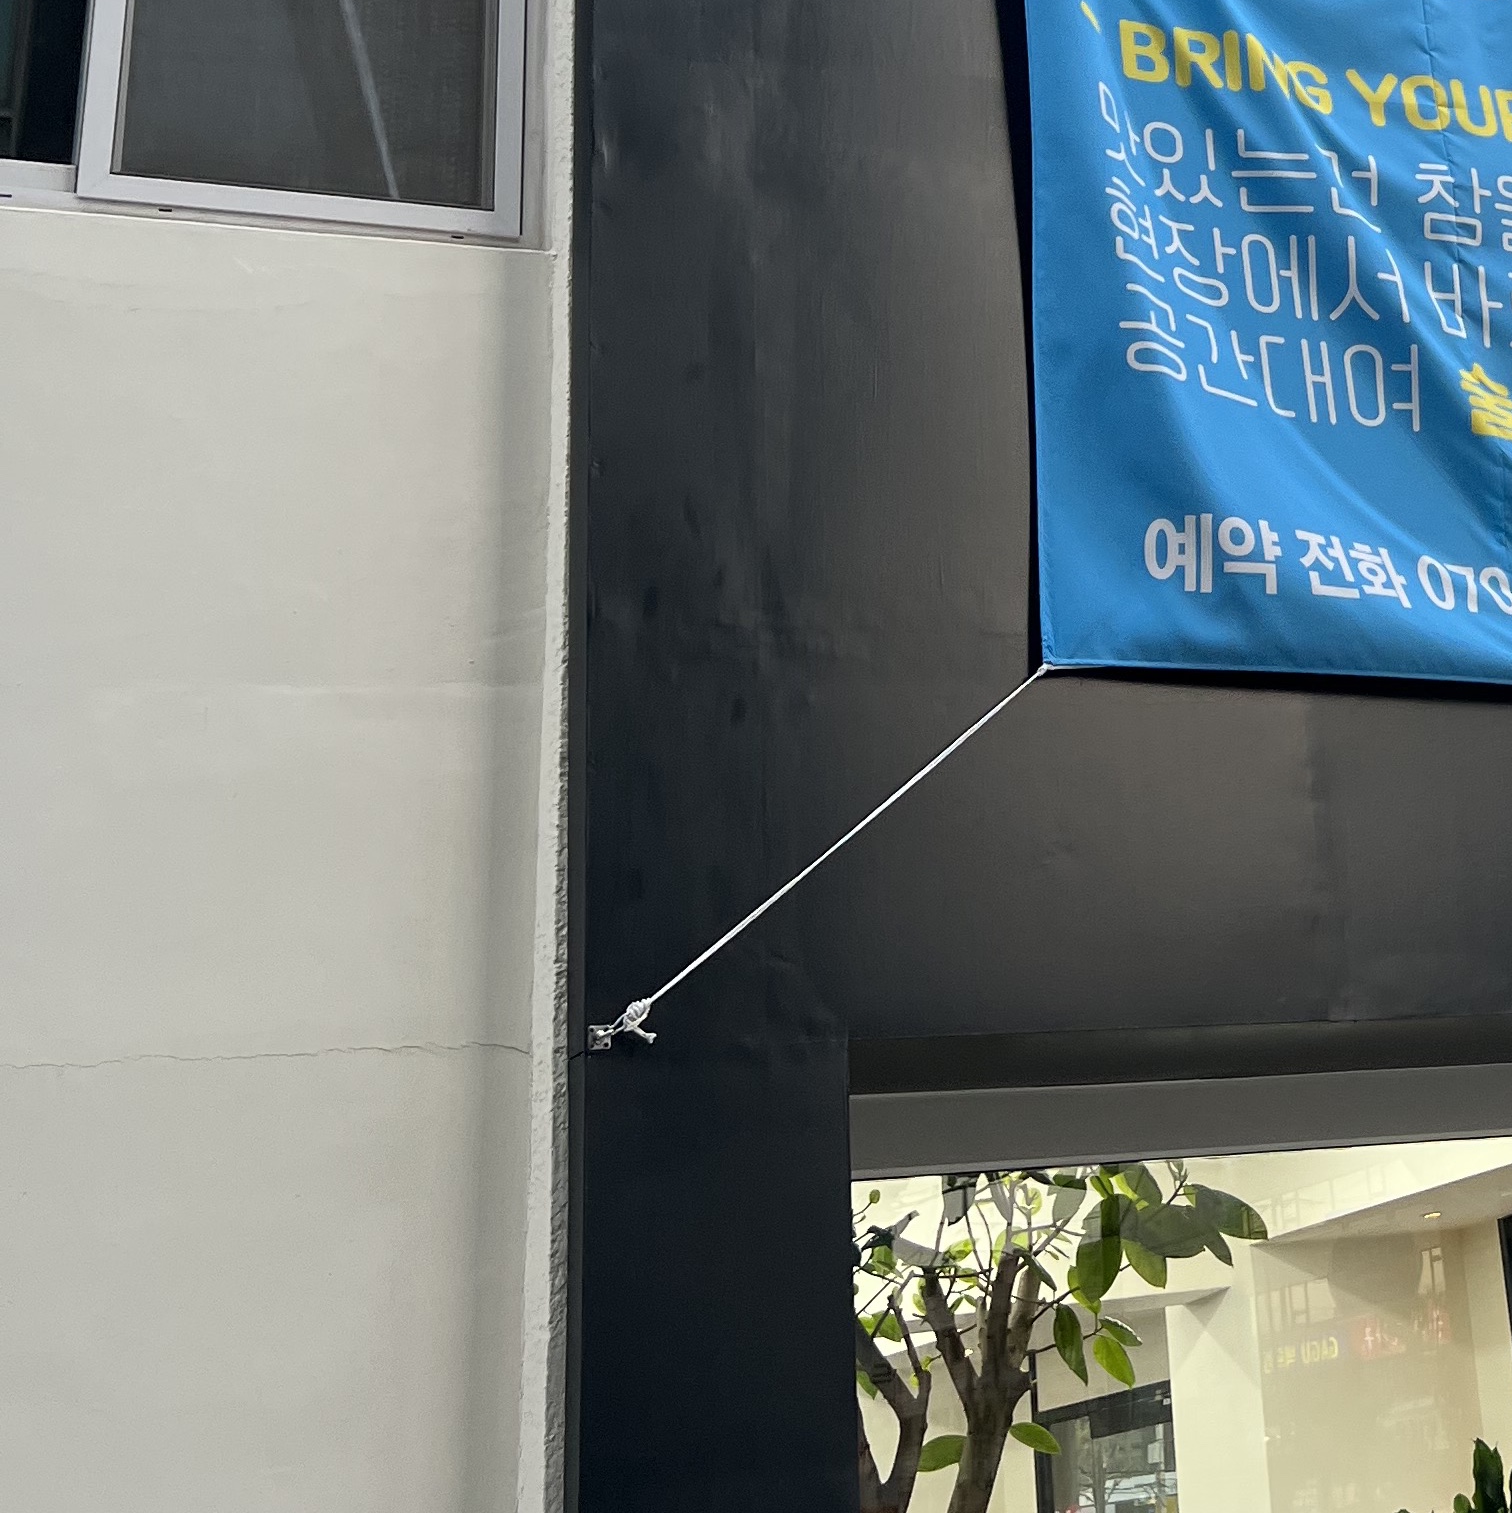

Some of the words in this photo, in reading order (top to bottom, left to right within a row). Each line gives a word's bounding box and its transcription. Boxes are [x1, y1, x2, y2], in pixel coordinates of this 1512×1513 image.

[1119, 19, 1333, 116] BRING
[1105, 175, 1410, 324] 현장에서
[1119, 283, 1420, 433] 공간대여
[1145, 513, 1282, 596] 예약
[1299, 529, 1411, 610] 전화
